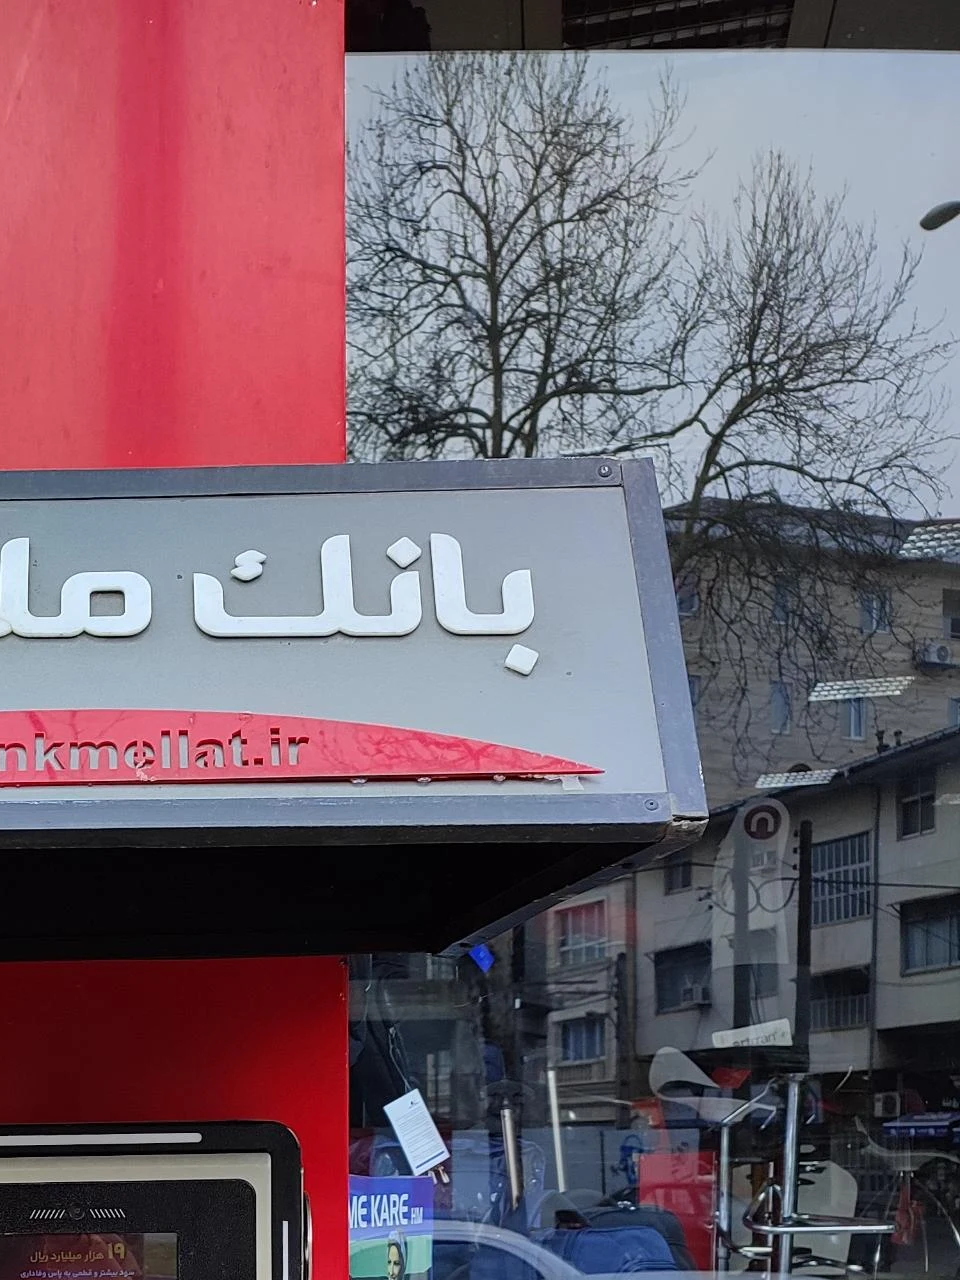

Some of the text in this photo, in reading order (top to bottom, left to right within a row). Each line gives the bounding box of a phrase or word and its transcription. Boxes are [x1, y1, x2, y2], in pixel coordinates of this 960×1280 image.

[192, 531, 539, 677] بانک
[370, 1193, 409, 1228] KARE
[30, 1250, 49, 1263] ریال
[50, 1250, 82, 1262] میلیارد
[84, 1251, 105, 1262] هزار
[20, 1270, 46, 1279] وفاداری
[48, 1269, 63, 1279] پاس
[72, 1269, 93, 1278] قطعی
[99, 1269, 118, 1278] بیشتر
[119, 1270, 135, 1278] سود
